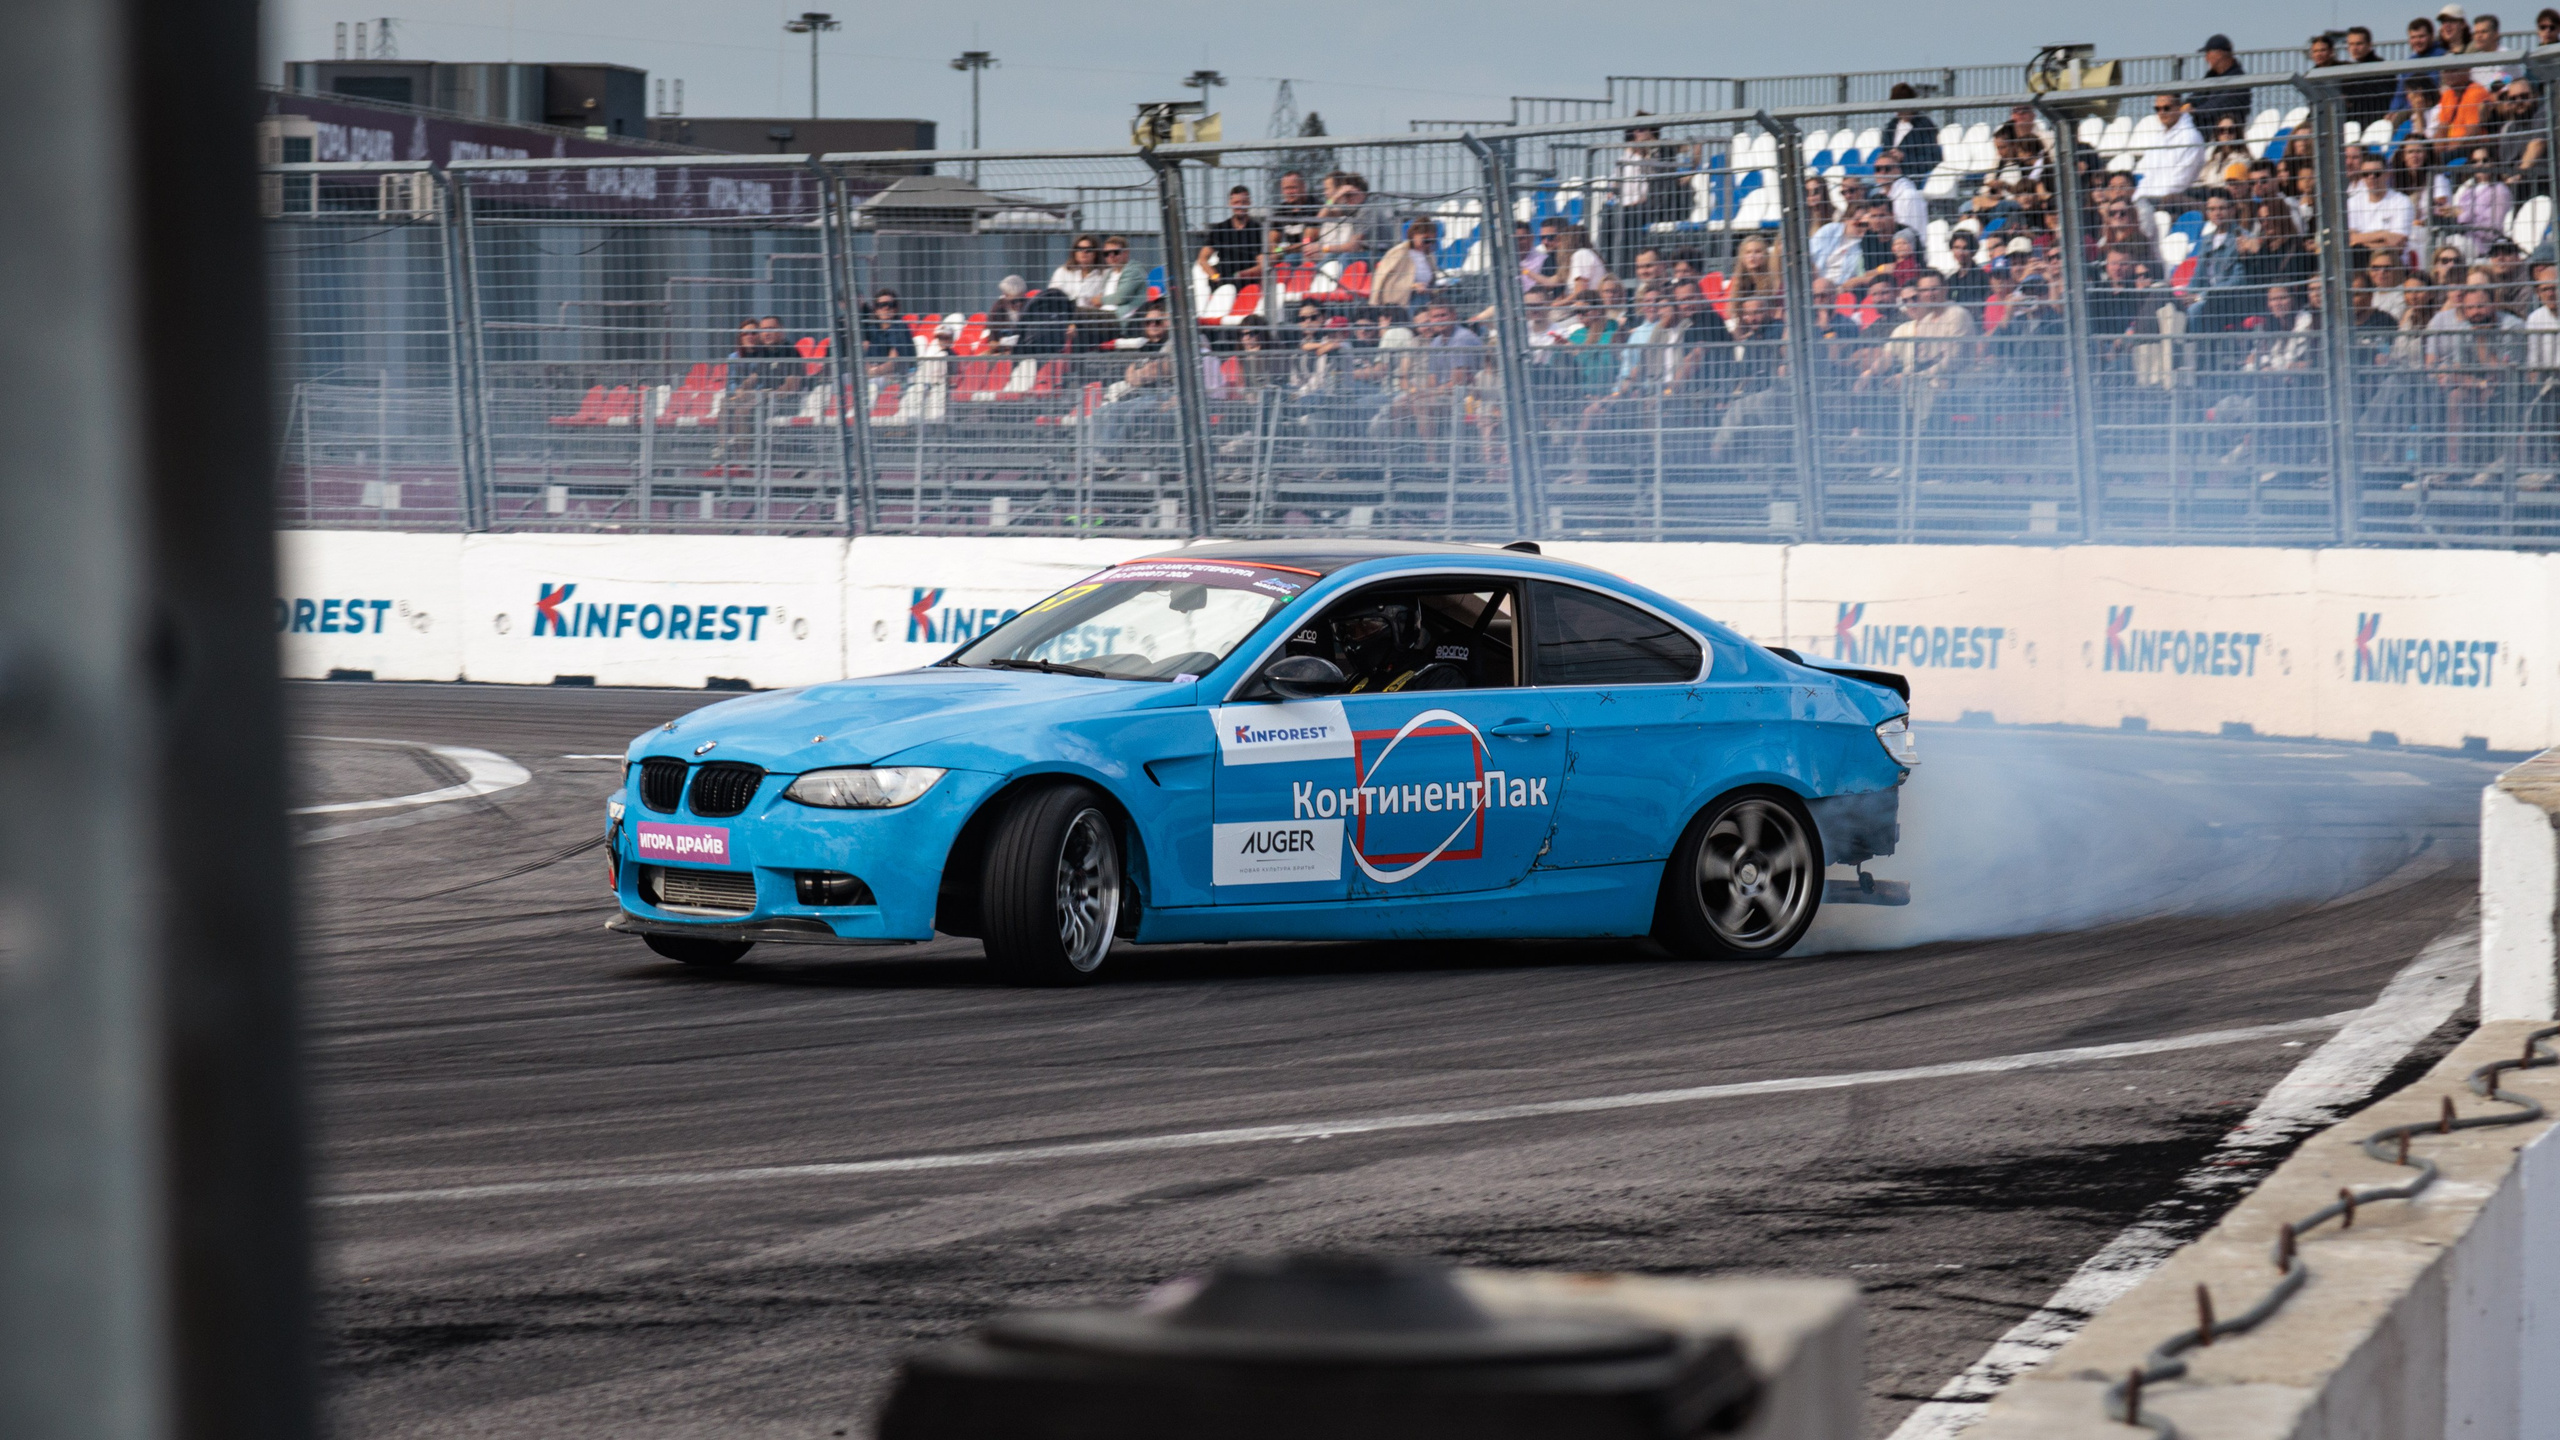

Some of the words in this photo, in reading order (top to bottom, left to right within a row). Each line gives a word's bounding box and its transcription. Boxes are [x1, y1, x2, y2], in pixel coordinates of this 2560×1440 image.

[532, 583, 769, 641] KINFOREST
[1834, 601, 2006, 670] KINFOREST
[2103, 605, 2263, 677] KINFOREST
[2352, 612, 2499, 688] KINFOREST
[1235, 725, 1328, 744] KINFOREST
[1292, 770, 1549, 820] КонтинентПак
[639, 832, 675, 851] ИГОРА
[676, 833, 724, 855] ДРАЙВ
[1240, 830, 1315, 854] AUGER
